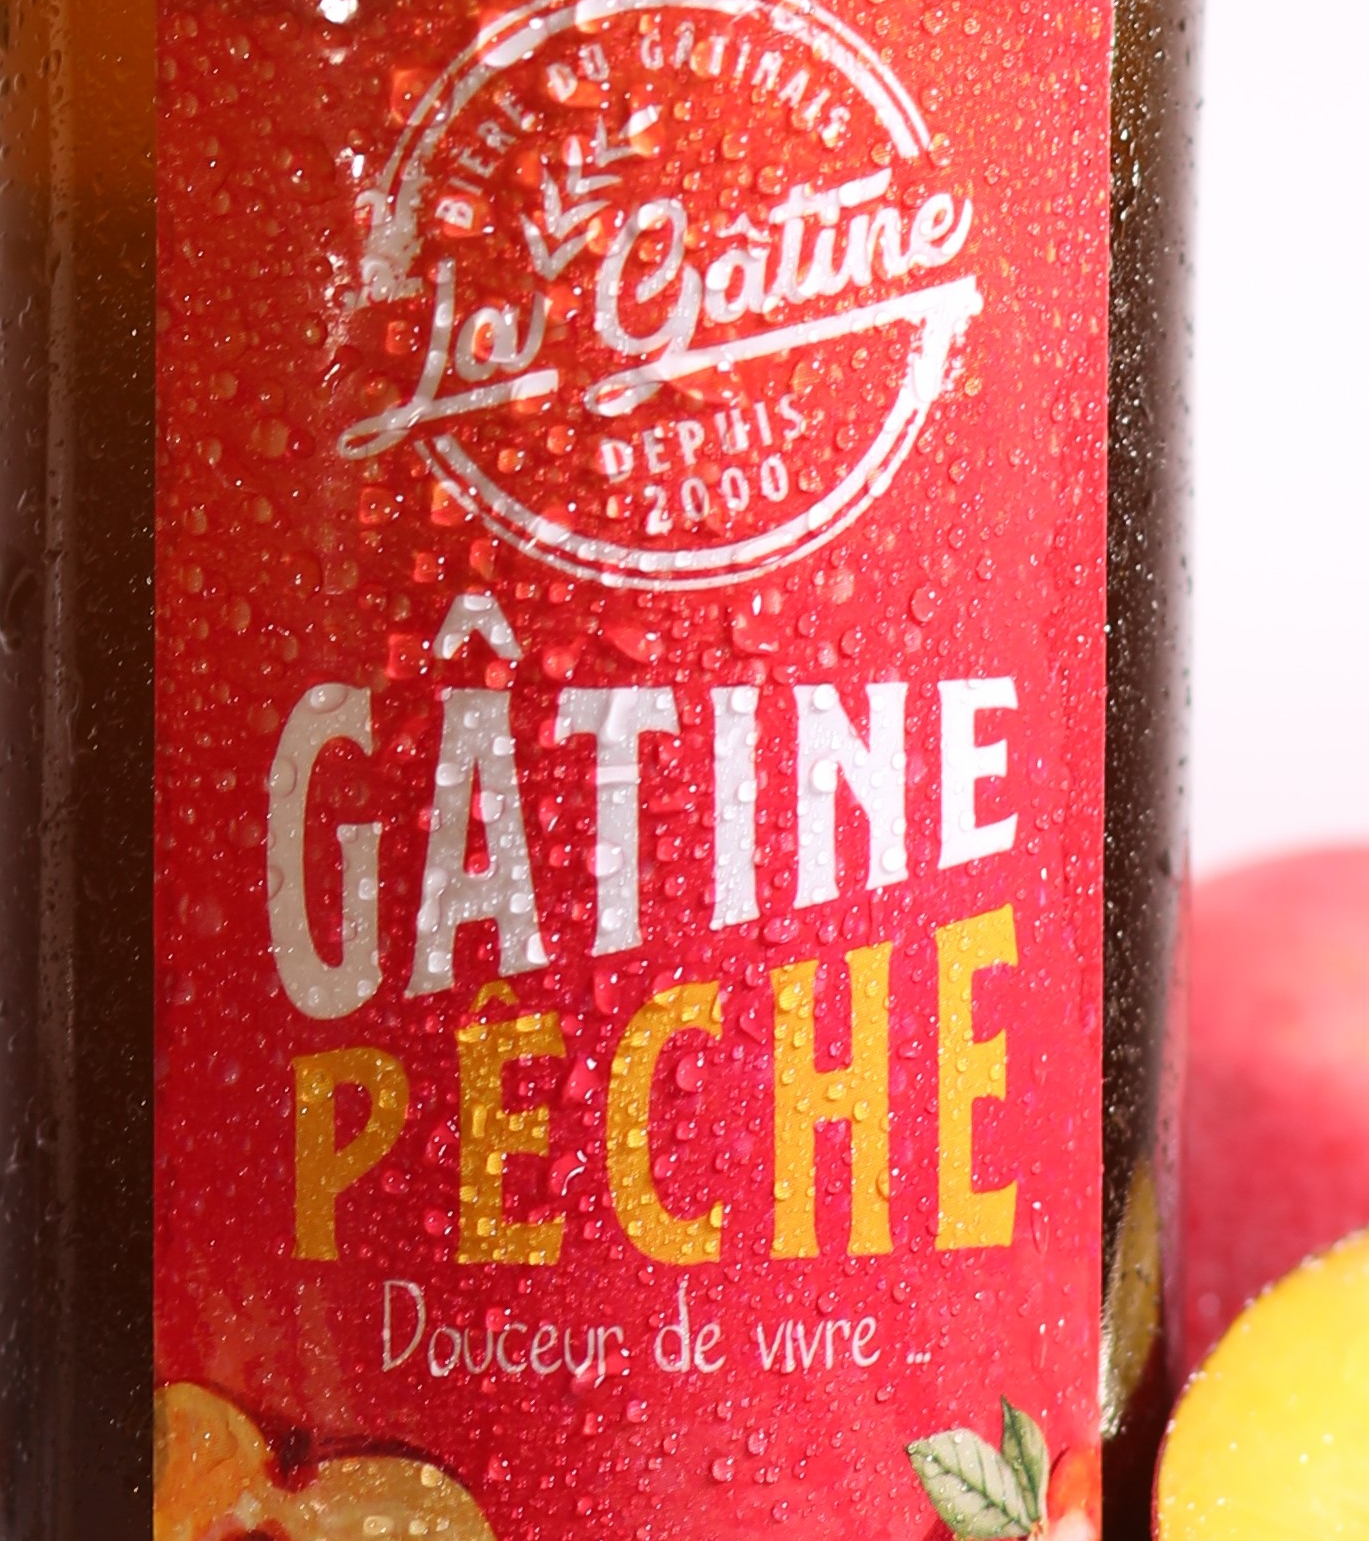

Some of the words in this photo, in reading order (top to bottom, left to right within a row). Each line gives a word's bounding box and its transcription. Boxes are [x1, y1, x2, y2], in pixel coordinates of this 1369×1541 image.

[545, 42, 610, 103] DU
[337, 258, 559, 460] La
[583, 168, 976, 418] Gâtine
[599, 392, 806, 483] DEPUIS
[644, 454, 789, 536] 2000
[266, 595, 1019, 1020] GÂTINE
[291, 903, 1019, 1266] PÊCHE
[382, 1279, 625, 1377] Douceur
[653, 1275, 727, 1373] de
[756, 1316, 882, 1373] vivre
